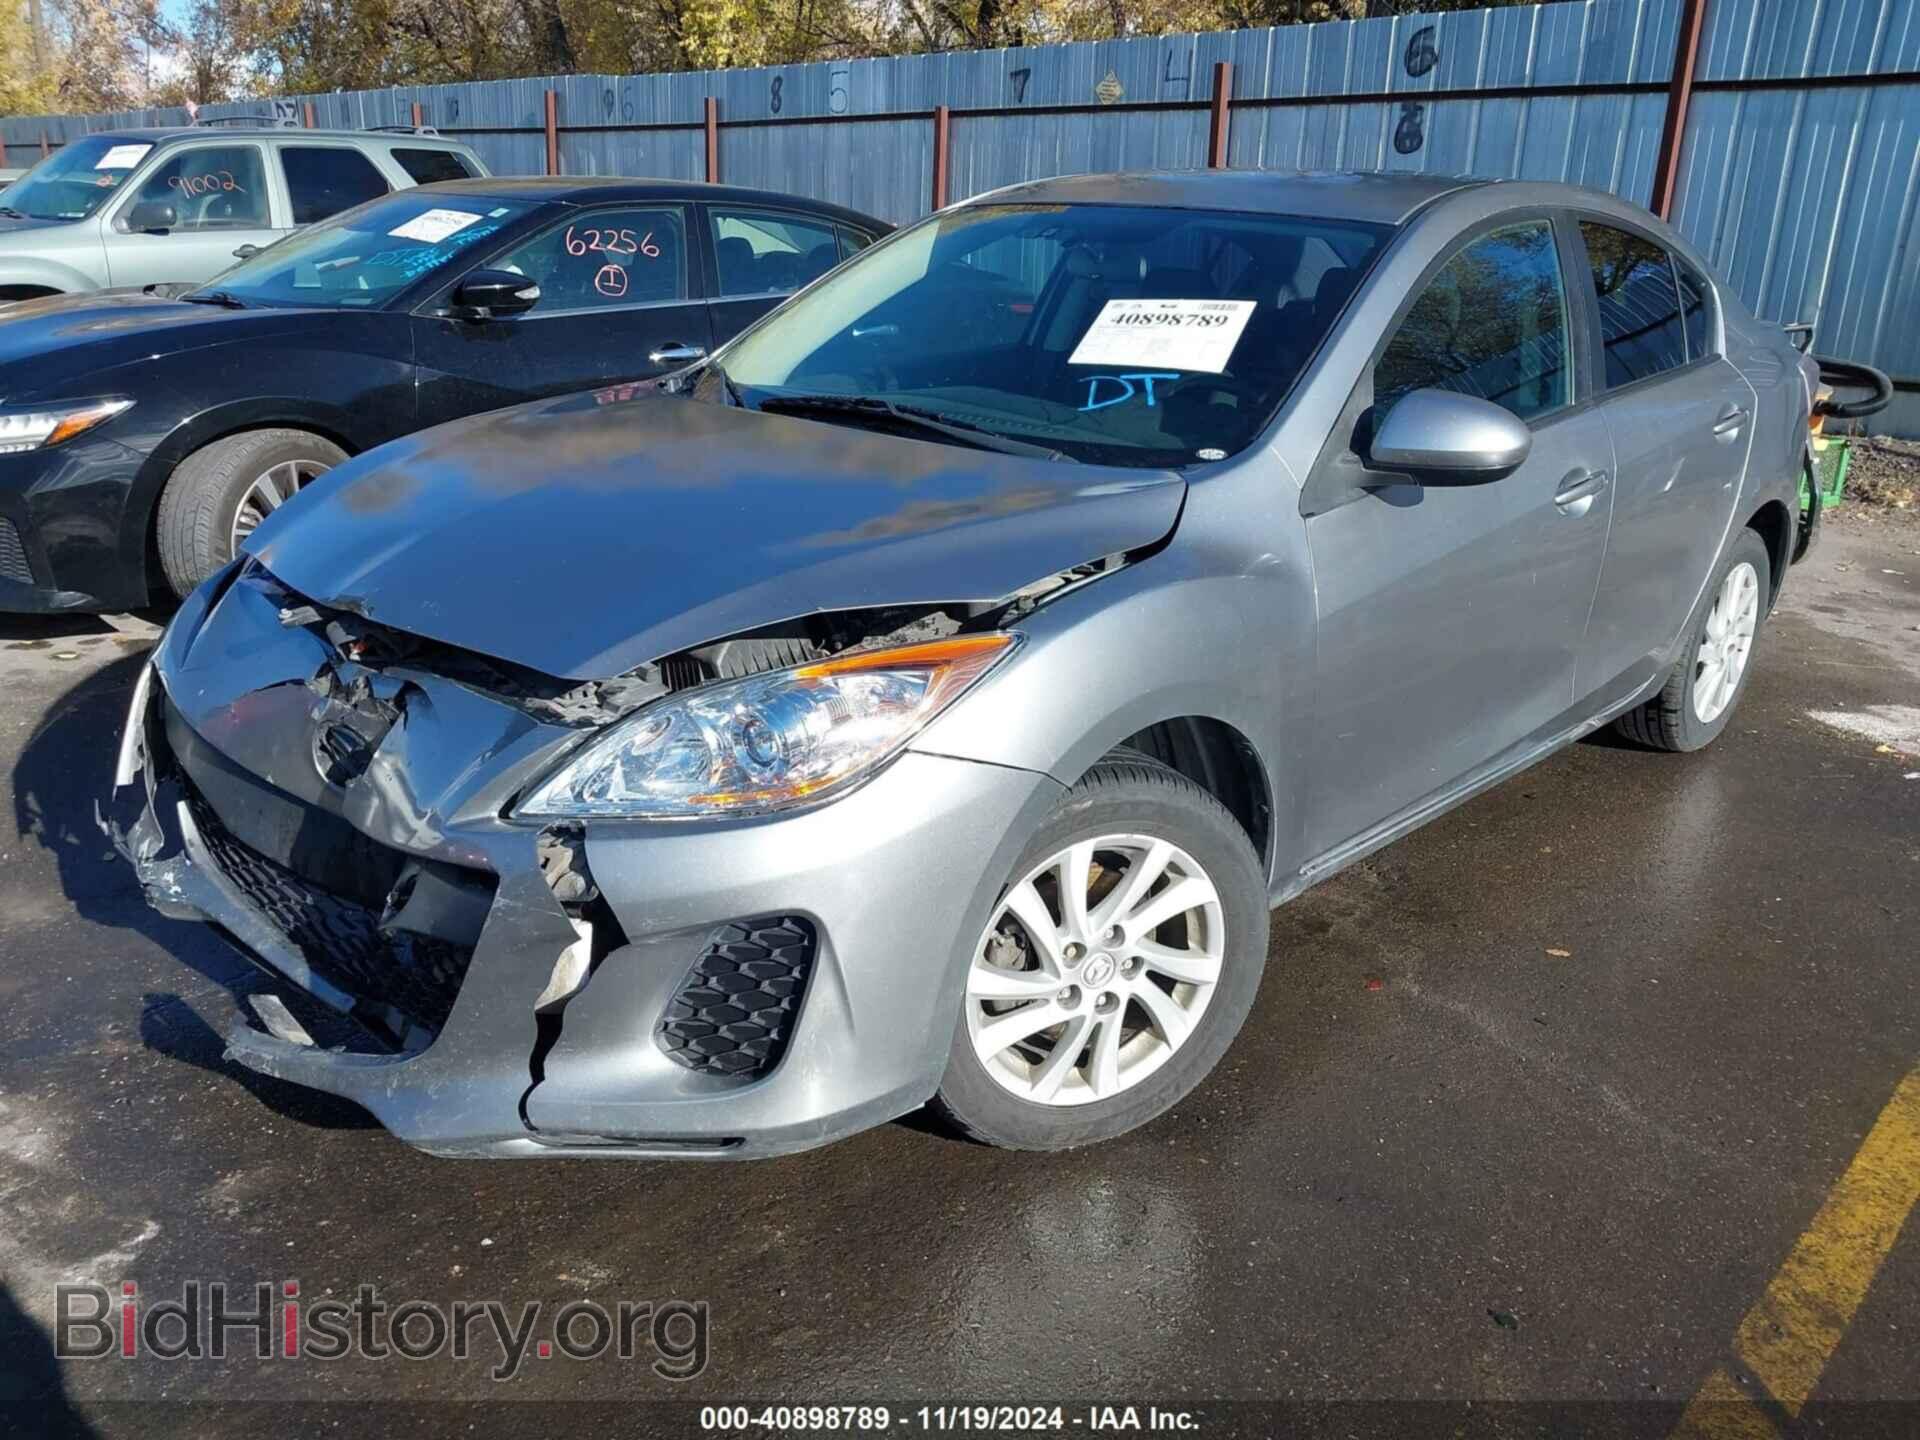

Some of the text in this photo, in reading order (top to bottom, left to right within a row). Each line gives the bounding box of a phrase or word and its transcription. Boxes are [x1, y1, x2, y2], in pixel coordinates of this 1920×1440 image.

[1404, 25, 1438, 78] 6
[829, 70, 848, 114] 5
[1010, 68, 1031, 102] 7
[1165, 49, 1192, 98] 4
[770, 76, 783, 114] 8
[566, 226, 660, 257] 62256
[1111, 312, 1229, 328] 40898789
[1077, 373, 1181, 412] DT
